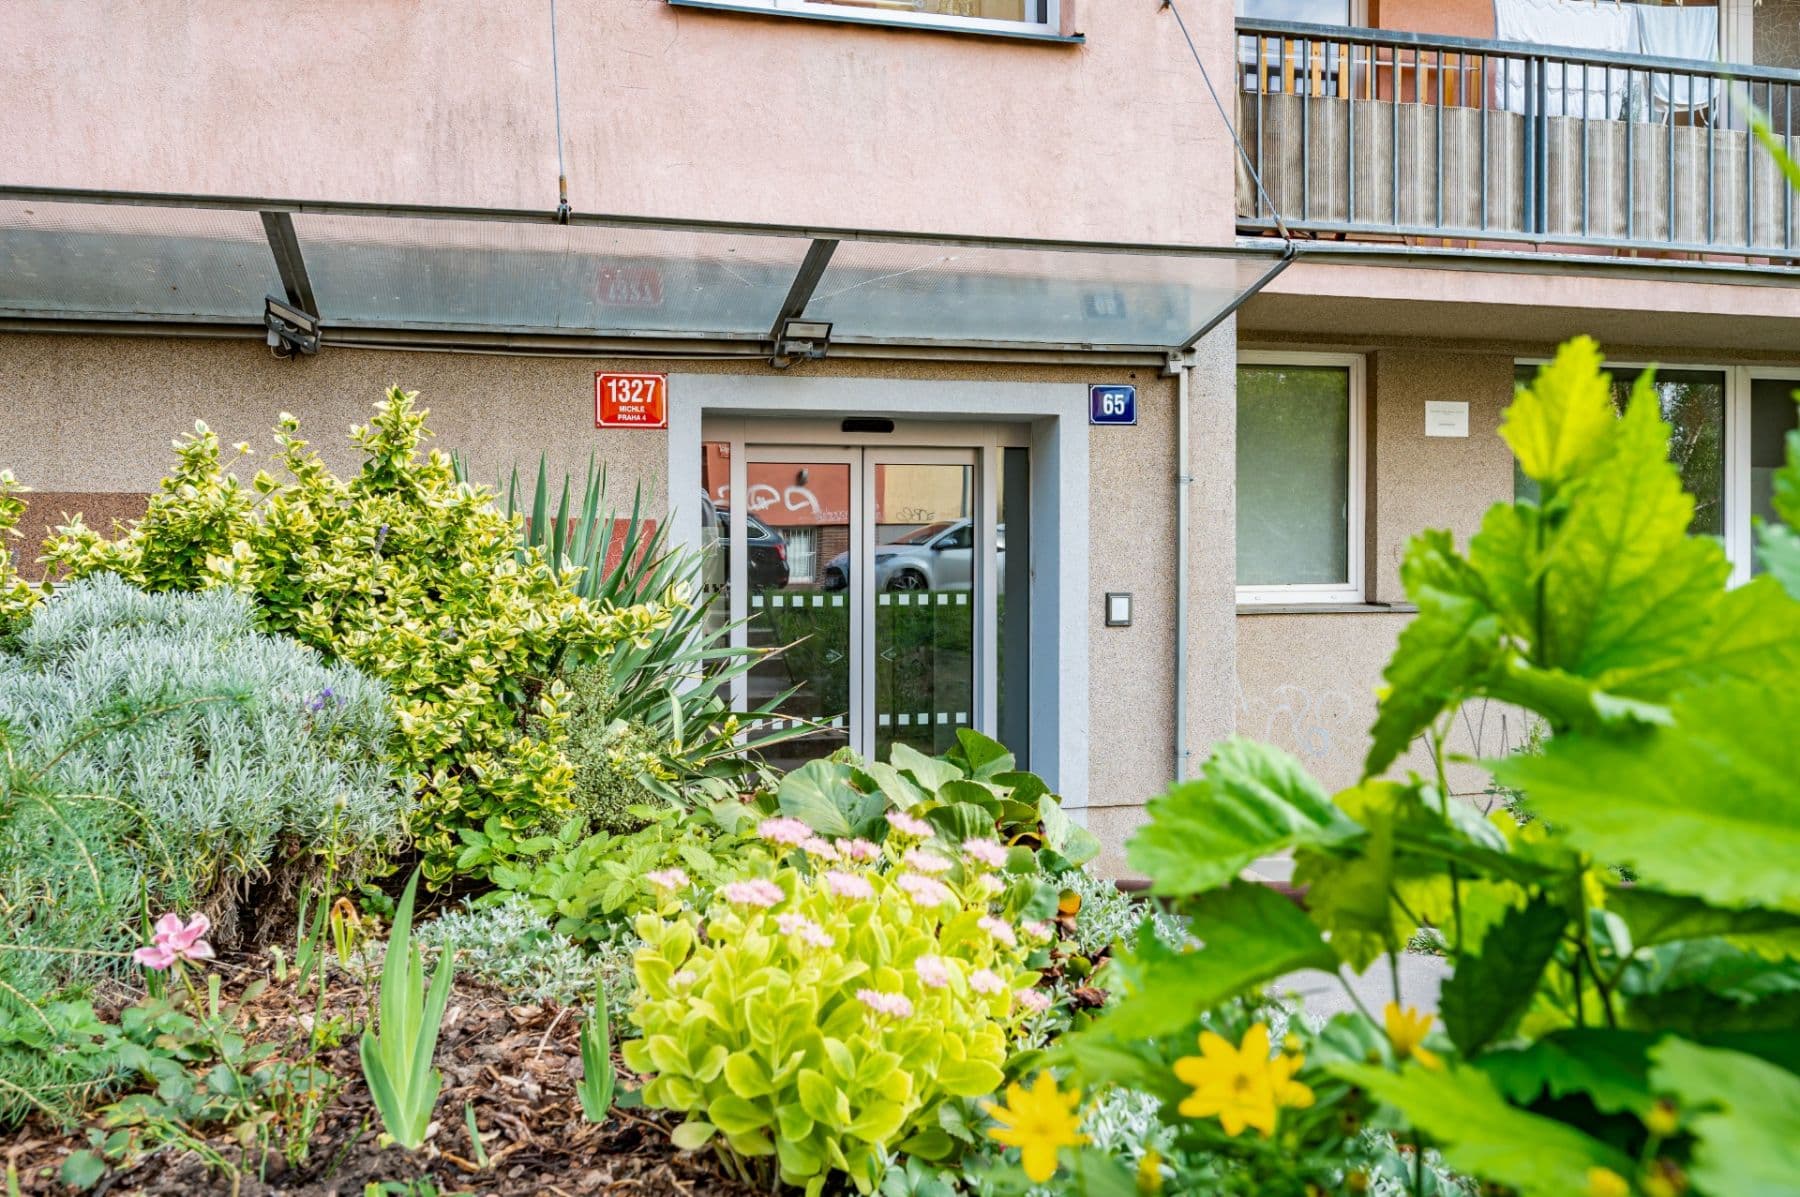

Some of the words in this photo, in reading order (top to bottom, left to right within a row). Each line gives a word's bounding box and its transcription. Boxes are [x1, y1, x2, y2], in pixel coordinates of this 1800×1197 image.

[607, 378, 656, 403] 1327
[618, 405, 646, 413] MICHLE
[1103, 393, 1125, 415] 65
[617, 413, 640, 421] PRAHA
